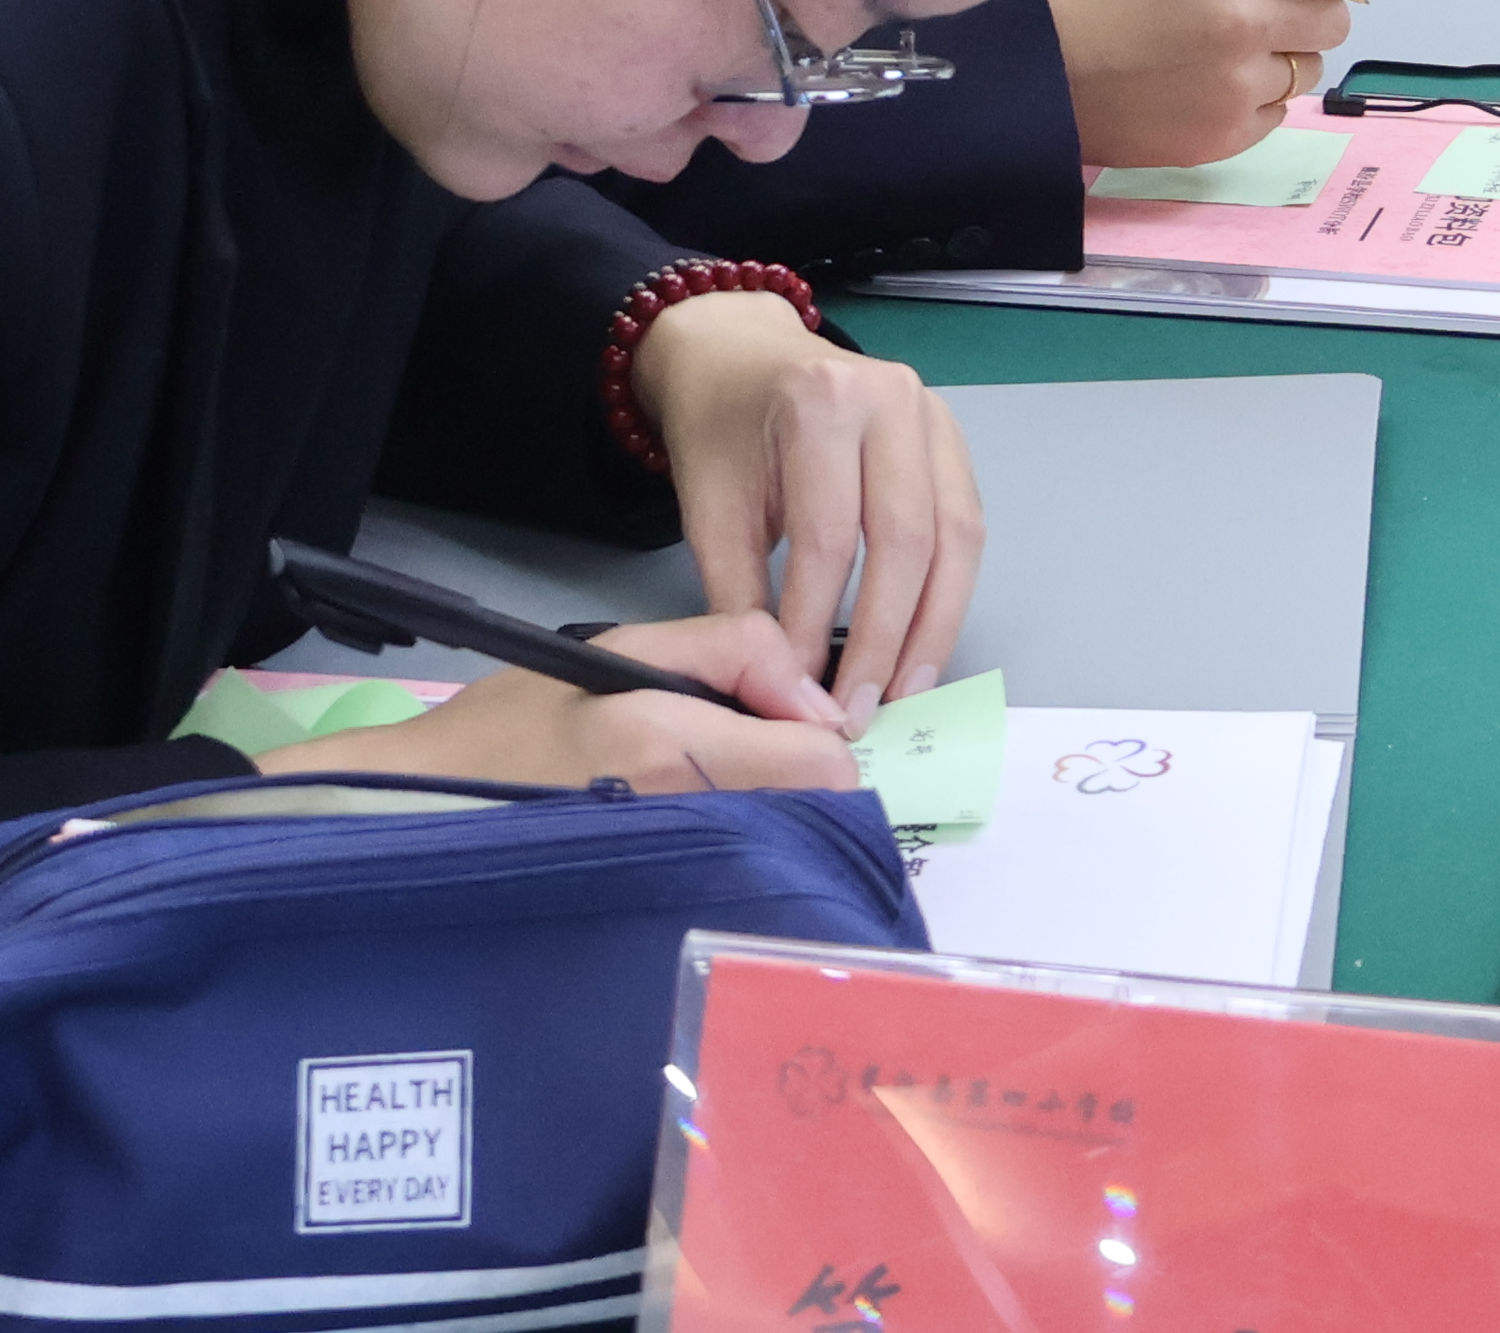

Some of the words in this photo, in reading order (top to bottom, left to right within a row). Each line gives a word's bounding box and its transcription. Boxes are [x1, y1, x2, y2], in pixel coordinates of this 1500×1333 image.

[320, 1079, 453, 1113] HEALTH
[328, 1129, 440, 1162] HAPPY
[317, 1179, 395, 1206] EVERY
[405, 1175, 450, 1202] DAY
